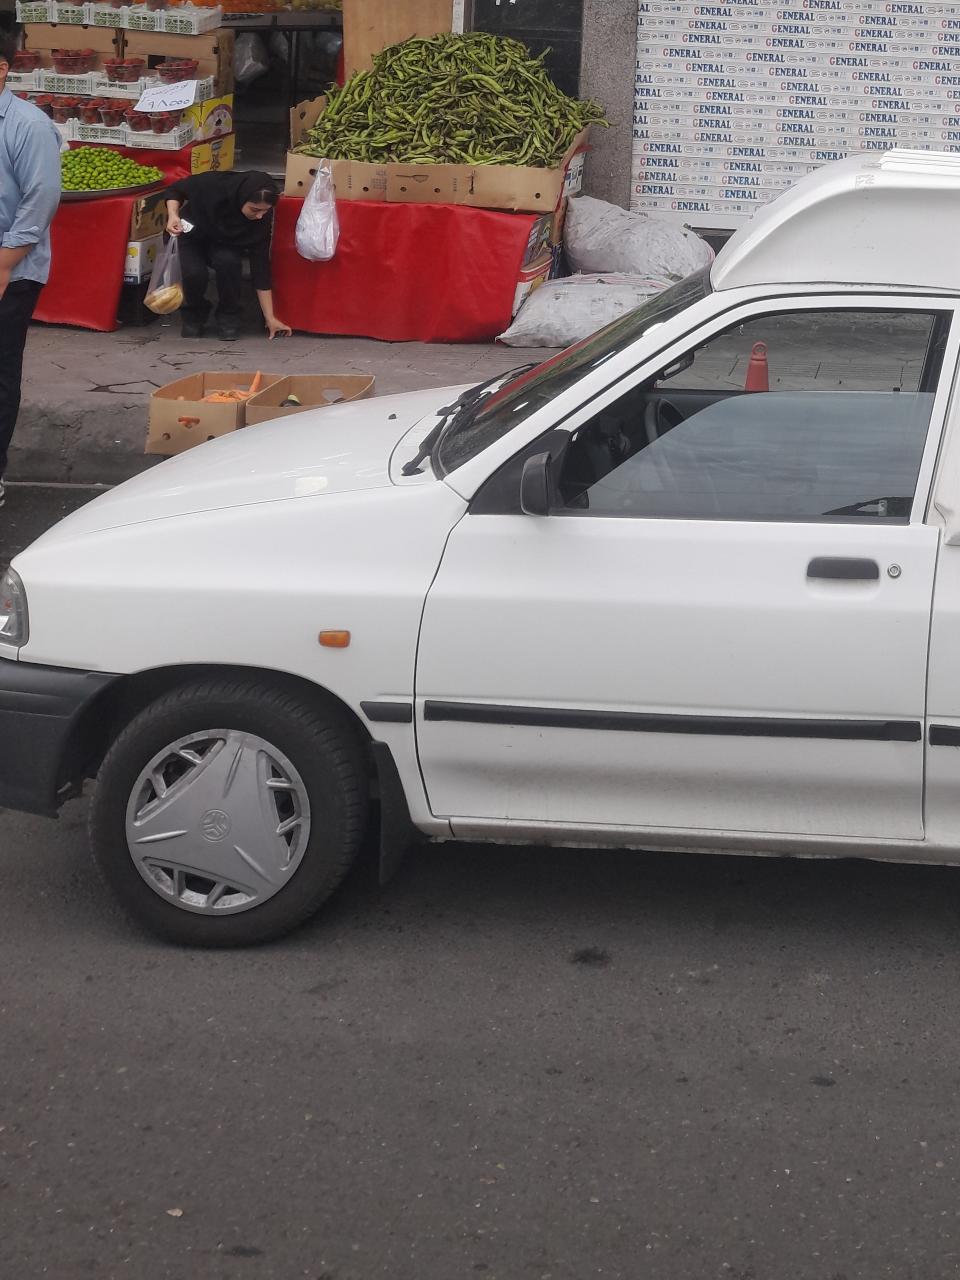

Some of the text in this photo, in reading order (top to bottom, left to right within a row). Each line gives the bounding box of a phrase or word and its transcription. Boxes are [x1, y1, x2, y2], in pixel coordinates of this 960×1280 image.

[802, 0, 841, 10] GENERAL
[885, 3, 924, 14] GENERAL
[776, 10, 815, 21] GENERAL
[682, 33, 721, 44] GENERAL
[746, 52, 785, 63] GENERAL
[829, 56, 868, 67] GENERAL
[912, 60, 951, 71] GENERAL
[685, 62, 724, 73] GENERAL
[697, 77, 736, 88] GENERAL
[780, 81, 819, 92] GENERAL
[863, 85, 902, 96] GENERAL
[871, 99, 910, 110] GENERAL
[693, 104, 732, 115] GENERAL
[776, 108, 815, 119] GENERAL
[859, 112, 898, 123] GENERAL
[692, 118, 731, 129] GENERAL
[775, 122, 814, 133] GENERAL
[643, 142, 682, 153] GENERAL
[723, 161, 762, 172] GENERAL
